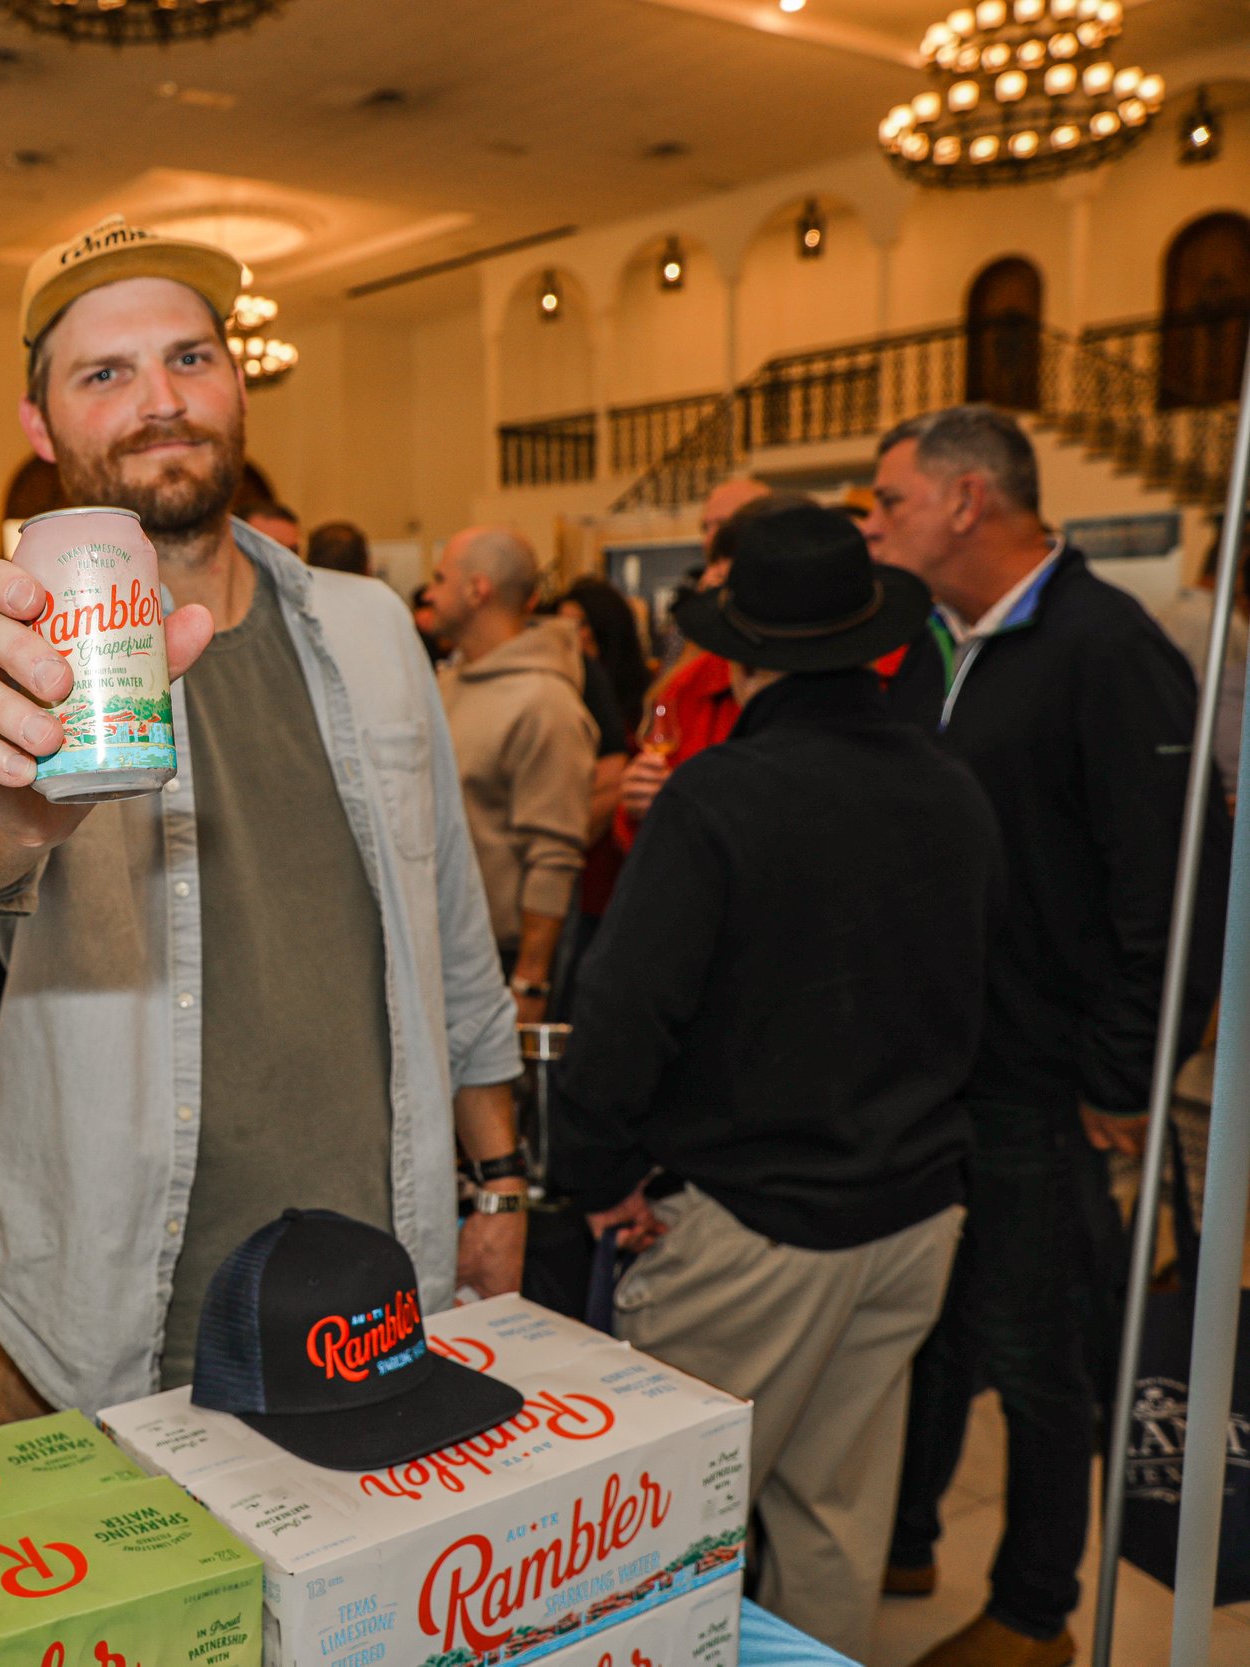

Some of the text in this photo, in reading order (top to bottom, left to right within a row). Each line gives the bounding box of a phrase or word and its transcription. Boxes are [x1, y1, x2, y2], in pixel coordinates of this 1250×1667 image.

[57, 544, 132, 566] TEXAS LIMESTONE
[77, 634, 153, 666] Grapefruit
[73, 677, 144, 690] PARKING WATER
[306, 1289, 420, 1382] Rambler
[7, 1438, 94, 1465] SPARKLING
[94, 1512, 189, 1543] SPARKLING
[101, 1507, 160, 1529] WATER
[418, 1472, 672, 1655] Rambler
[338, 1593, 378, 1624] TEXAS
[197, 1611, 241, 1639] IN Proud
[320, 1611, 396, 1656] LIMESTONE
[188, 1634, 248, 1661] PARTNERSHIP
[206, 1651, 230, 1665] WITH
